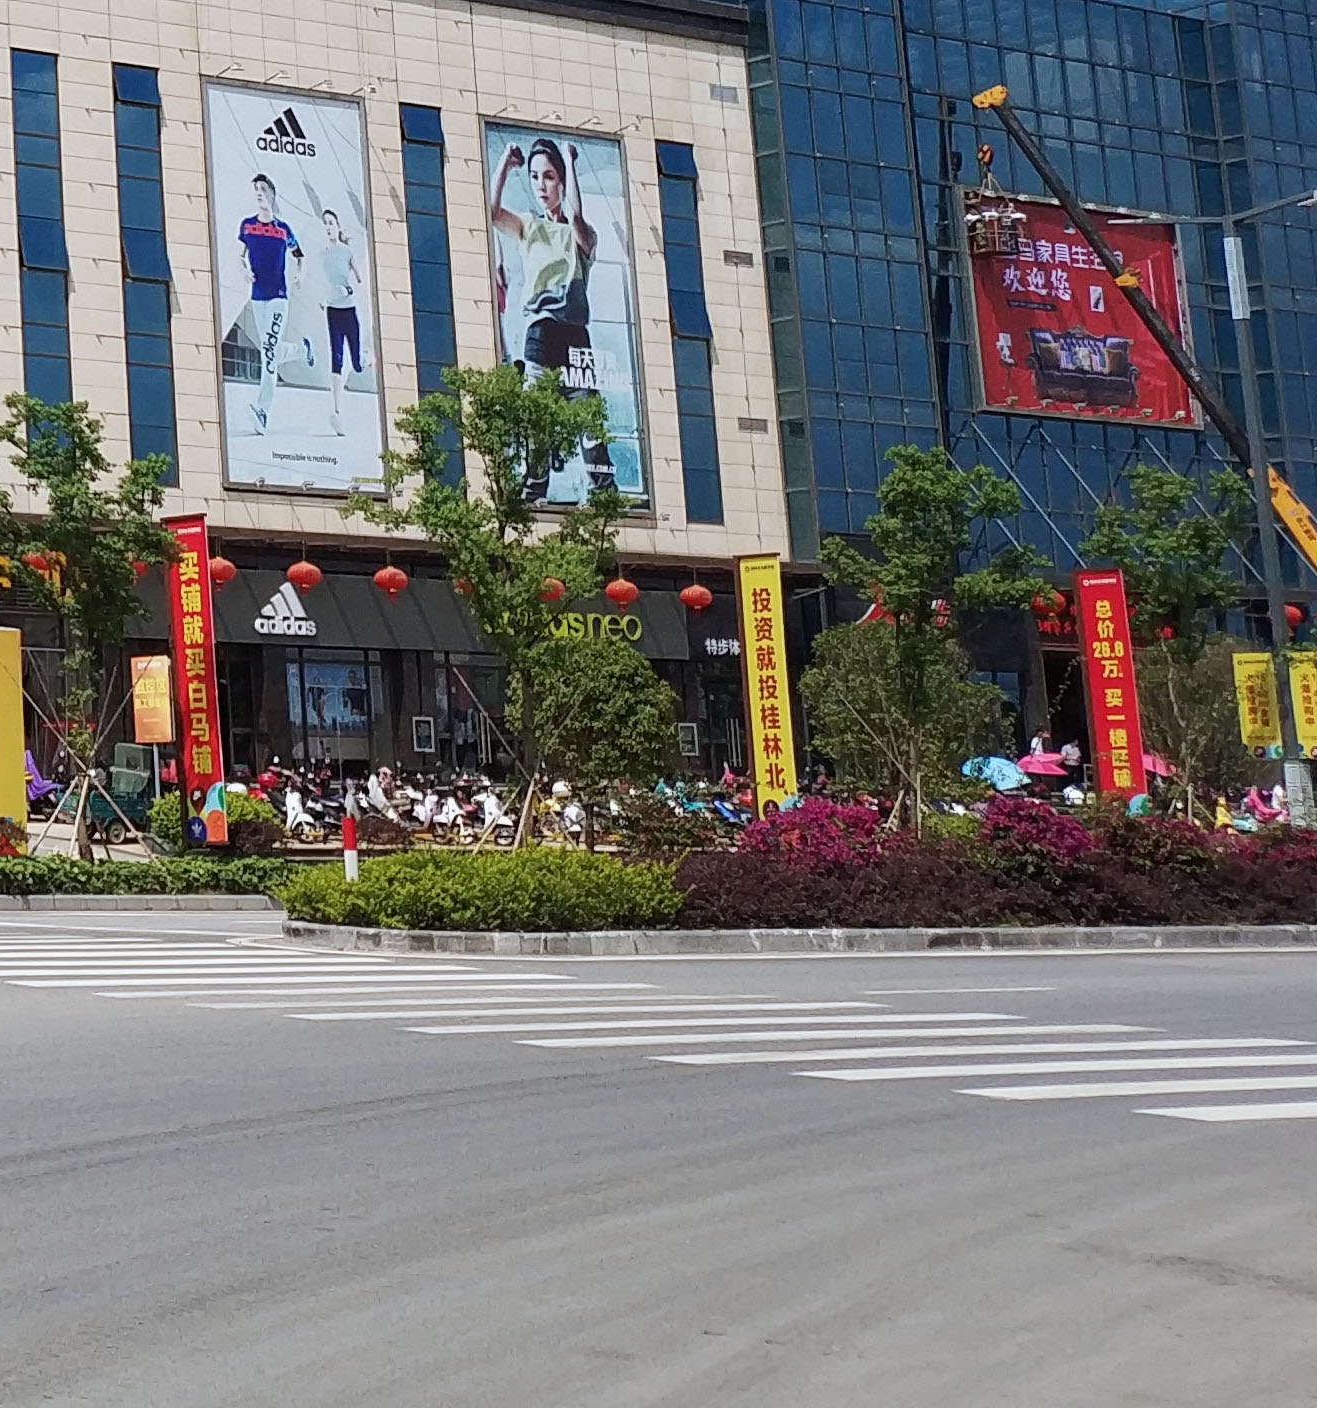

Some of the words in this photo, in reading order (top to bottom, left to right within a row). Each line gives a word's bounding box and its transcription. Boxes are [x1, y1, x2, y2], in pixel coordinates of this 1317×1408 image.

[256, 135, 317, 158] adidas
[1003, 263, 1072, 301] 欢迎您
[262, 311, 284, 376] adidas
[272, 451, 306, 461] Impossible
[254, 616, 317, 637] adidas
[179, 551, 213, 775] 买铺就买白马铺
[752, 587, 786, 791] 投资就投桂林北
